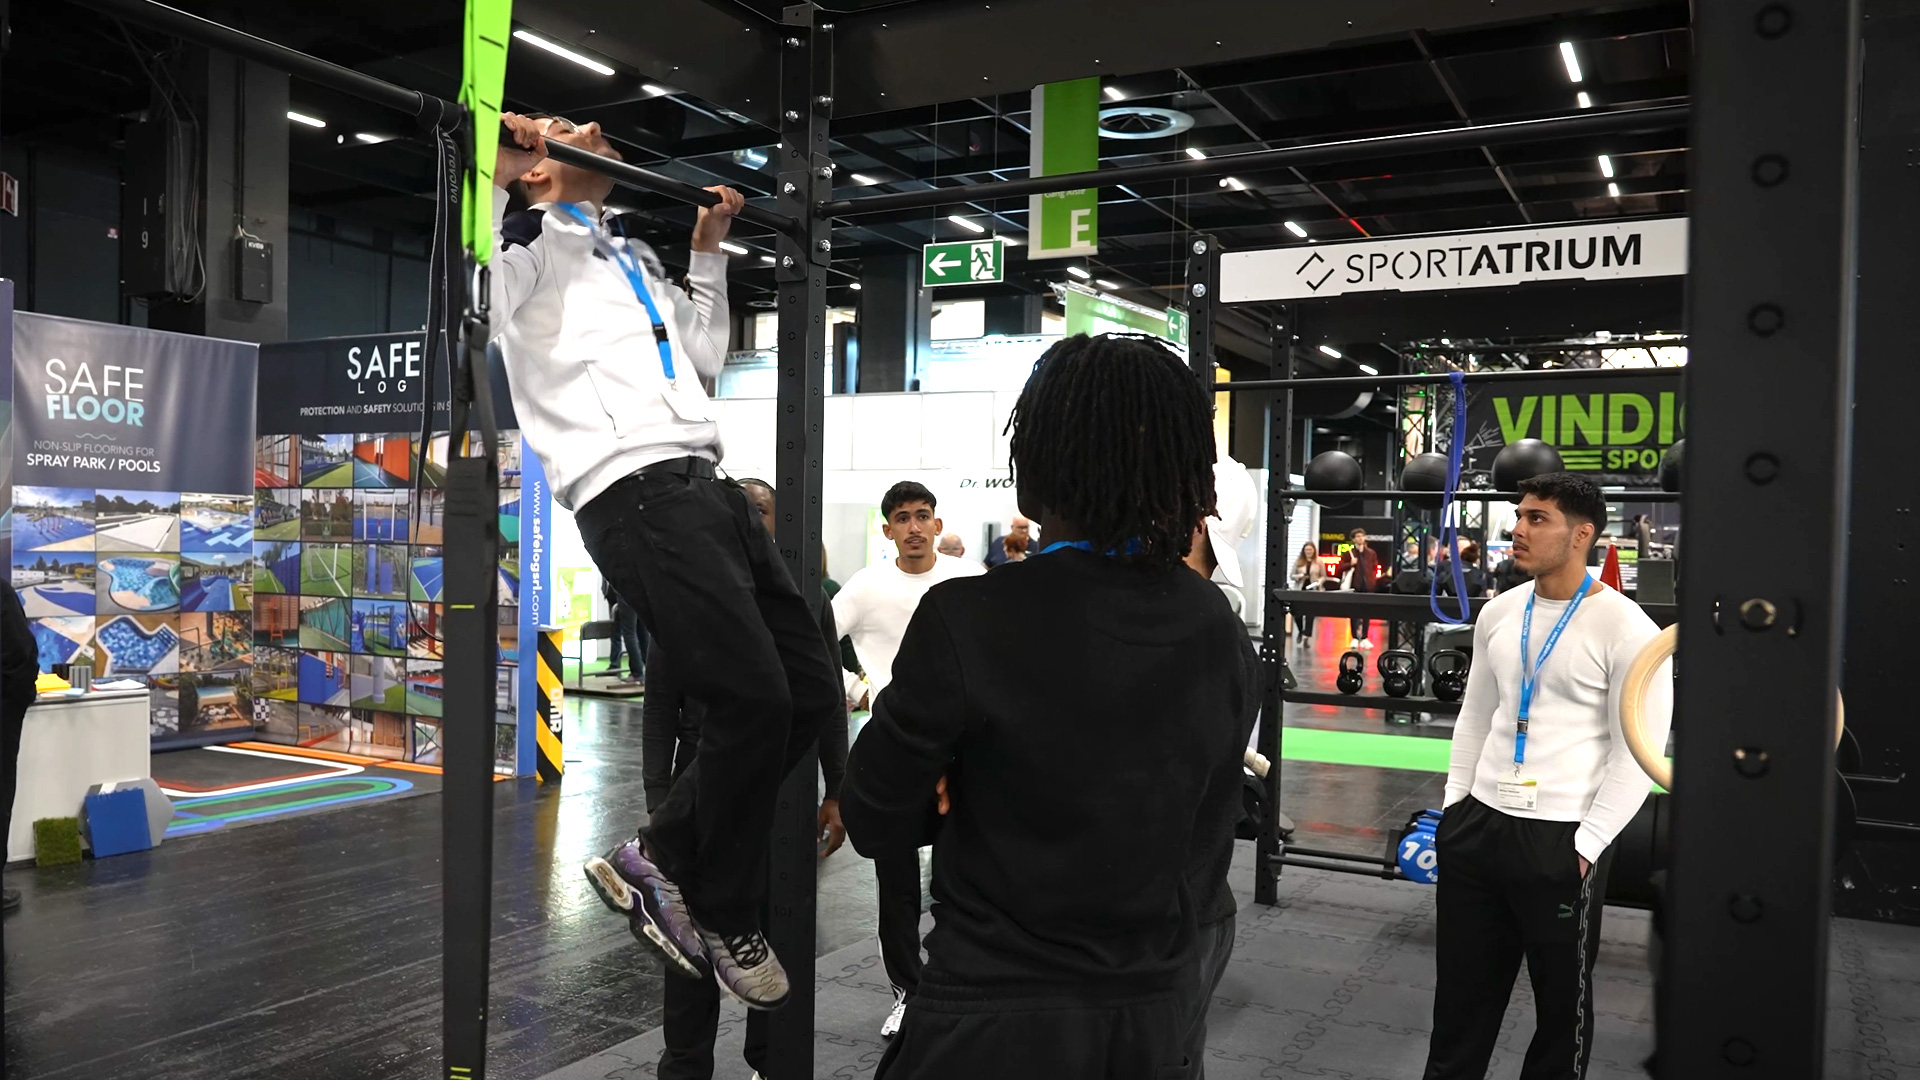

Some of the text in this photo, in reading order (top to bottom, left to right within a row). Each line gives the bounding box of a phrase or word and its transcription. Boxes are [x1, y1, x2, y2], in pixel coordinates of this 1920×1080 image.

[1070, 208, 1091, 247] E
[347, 341, 421, 380] SAFE
[44, 358, 144, 403] SAFE
[46, 394, 145, 428] FLOOR
[300, 405, 345, 416] PROTECTION
[346, 404, 363, 415] AND
[363, 403, 392, 414] SAFETY
[392, 402, 435, 413] SOLUTIO
[1492, 392, 1685, 447] VINDI
[26, 453, 70, 468] SPRAY
[73, 455, 106, 470] PARK
[118, 459, 161, 473] POOLS
[33, 440, 155, 457] NON-SLIP FLOORING FOR
[960, 477, 1017, 488] Dr. WO
[530, 480, 543, 625] www.safelogsrl.com
[1402, 841, 1438, 870] 10
